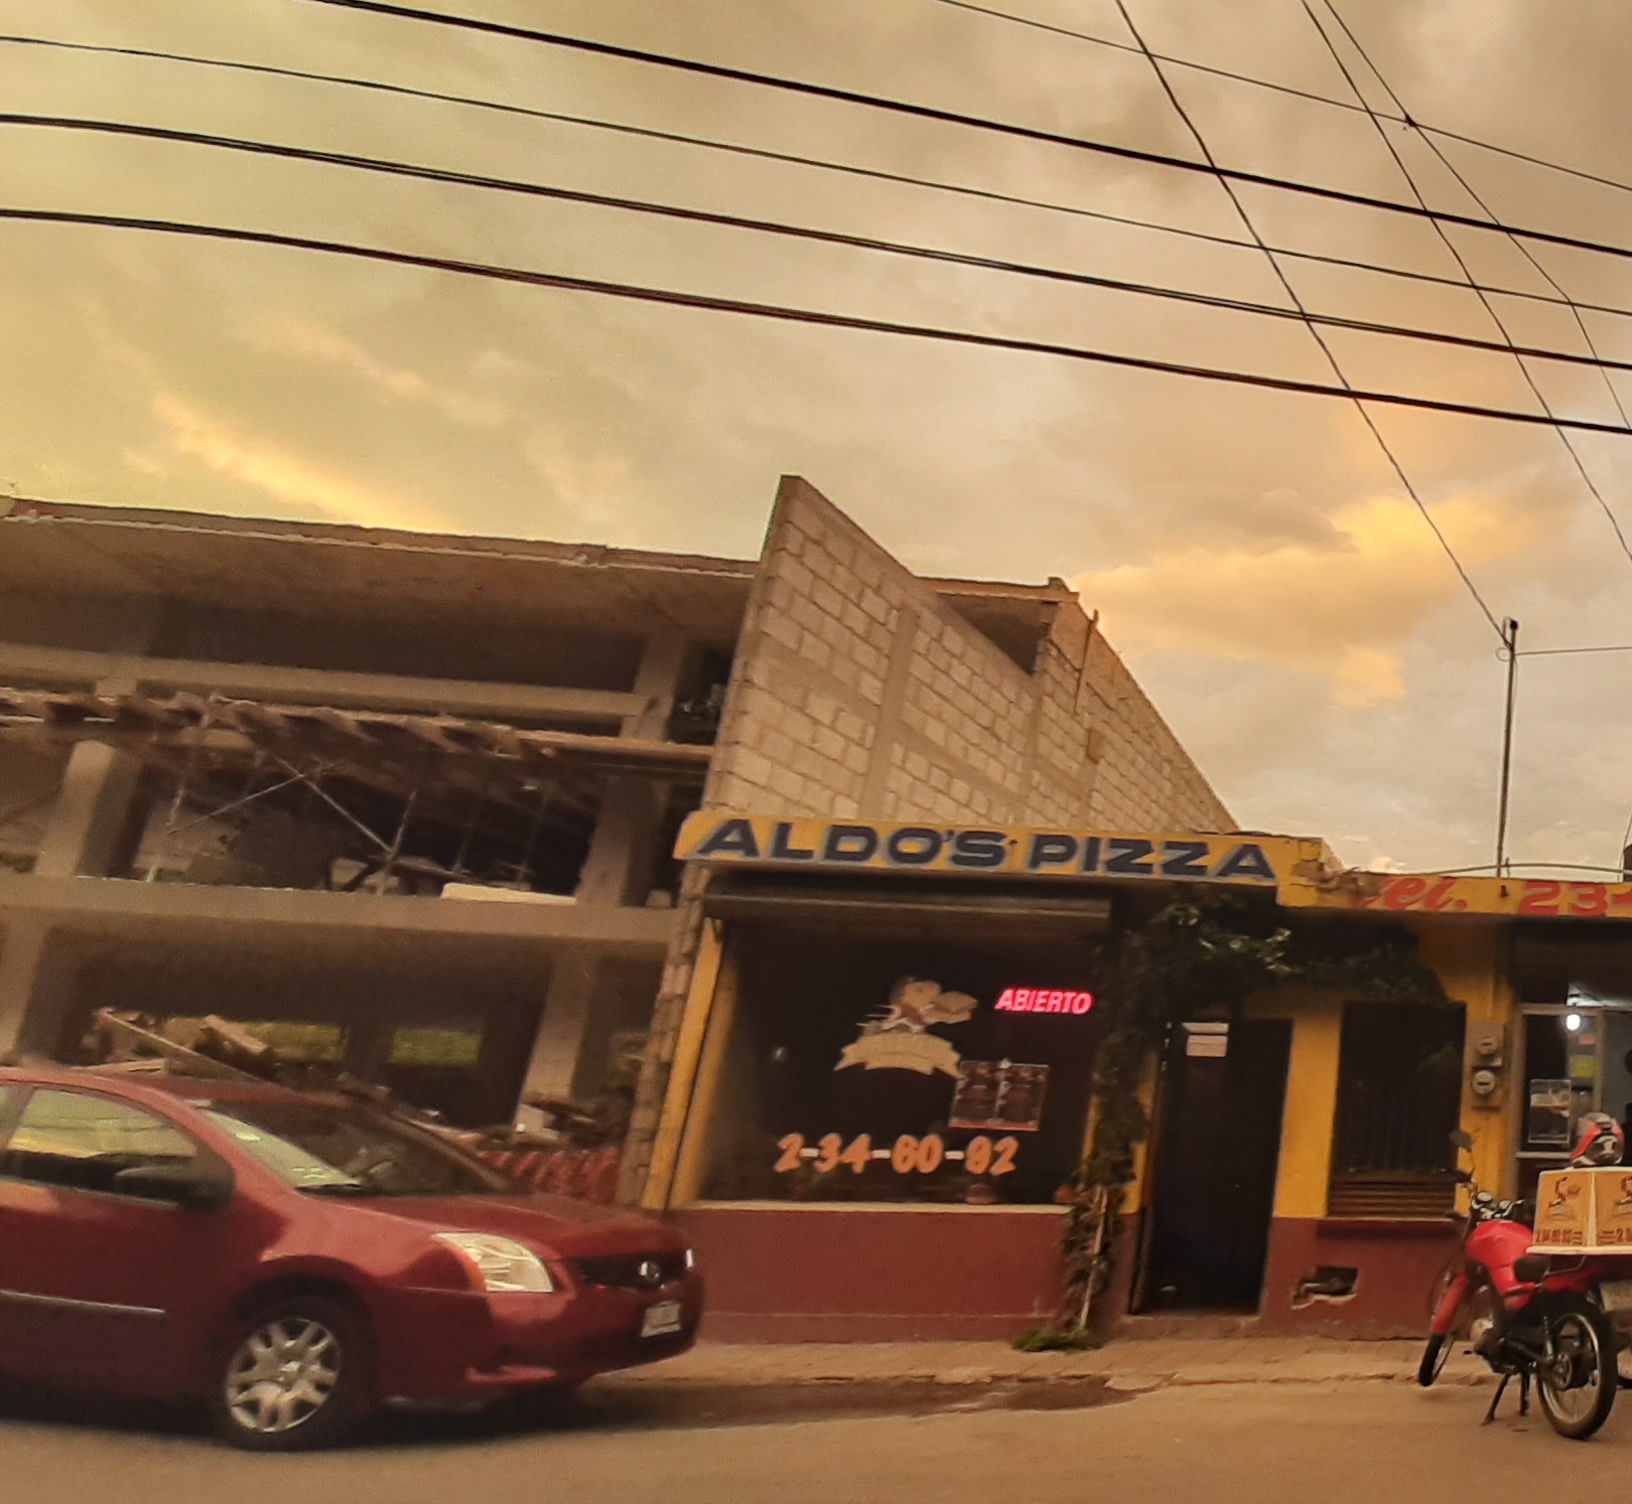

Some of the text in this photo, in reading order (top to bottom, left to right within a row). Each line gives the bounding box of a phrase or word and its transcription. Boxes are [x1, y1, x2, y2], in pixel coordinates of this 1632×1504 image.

[697, 818, 1276, 880] ALDO'S PIZZA
[995, 986, 1094, 1014] ABIERTO
